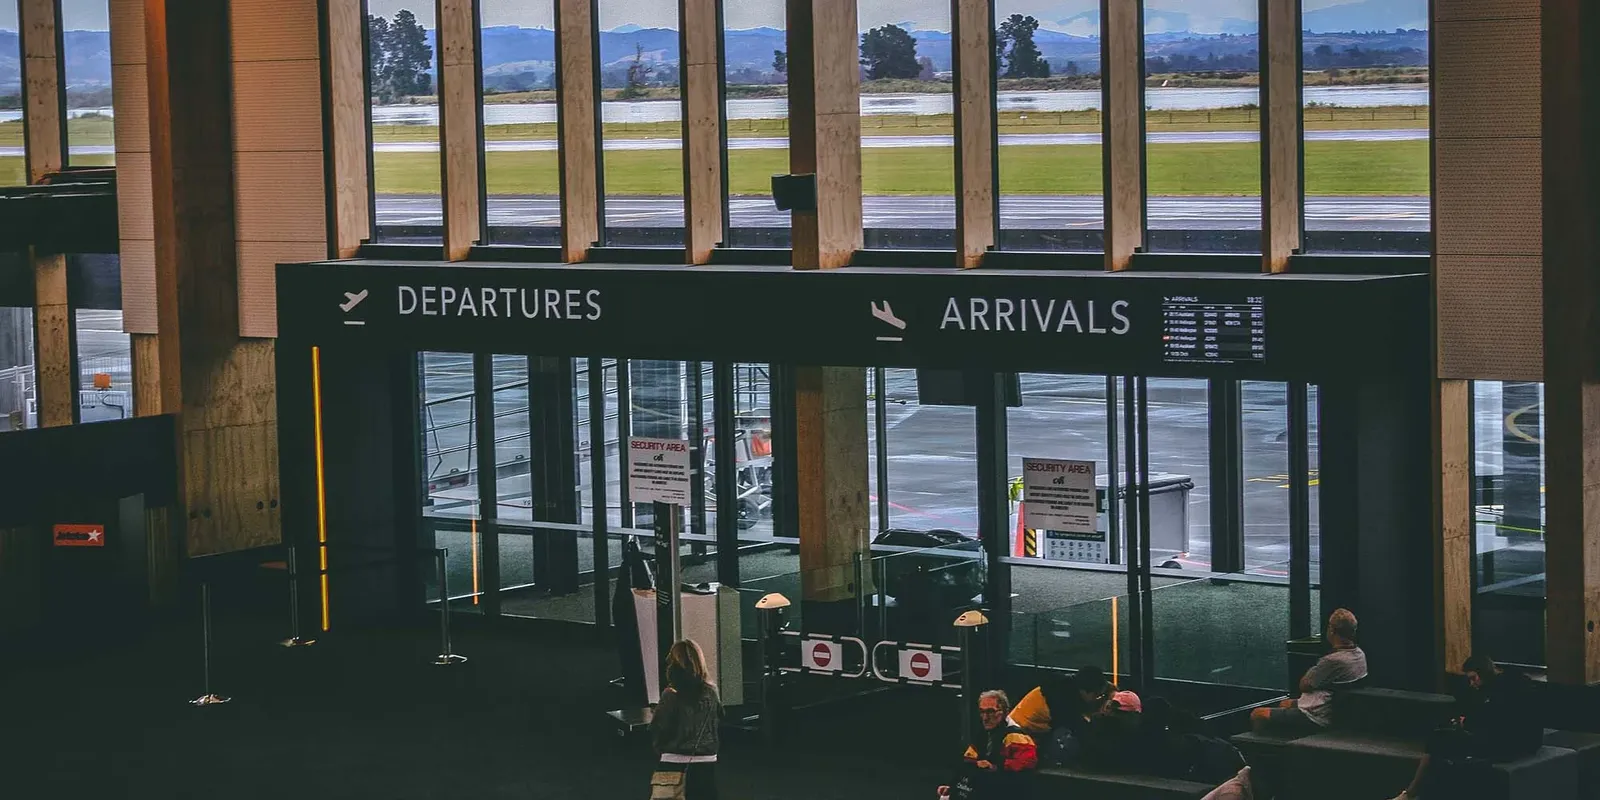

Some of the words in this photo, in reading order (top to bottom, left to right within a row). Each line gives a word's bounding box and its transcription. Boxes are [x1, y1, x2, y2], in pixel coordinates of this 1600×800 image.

[398, 286, 601, 320] DEPARTURES
[940, 297, 1131, 335] ARRIVALS
[631, 441, 664, 450] SECURITY
[666, 443, 686, 452] AREA
[1026, 462, 1066, 472] SECURITY
[1068, 464, 1091, 474] AREA
